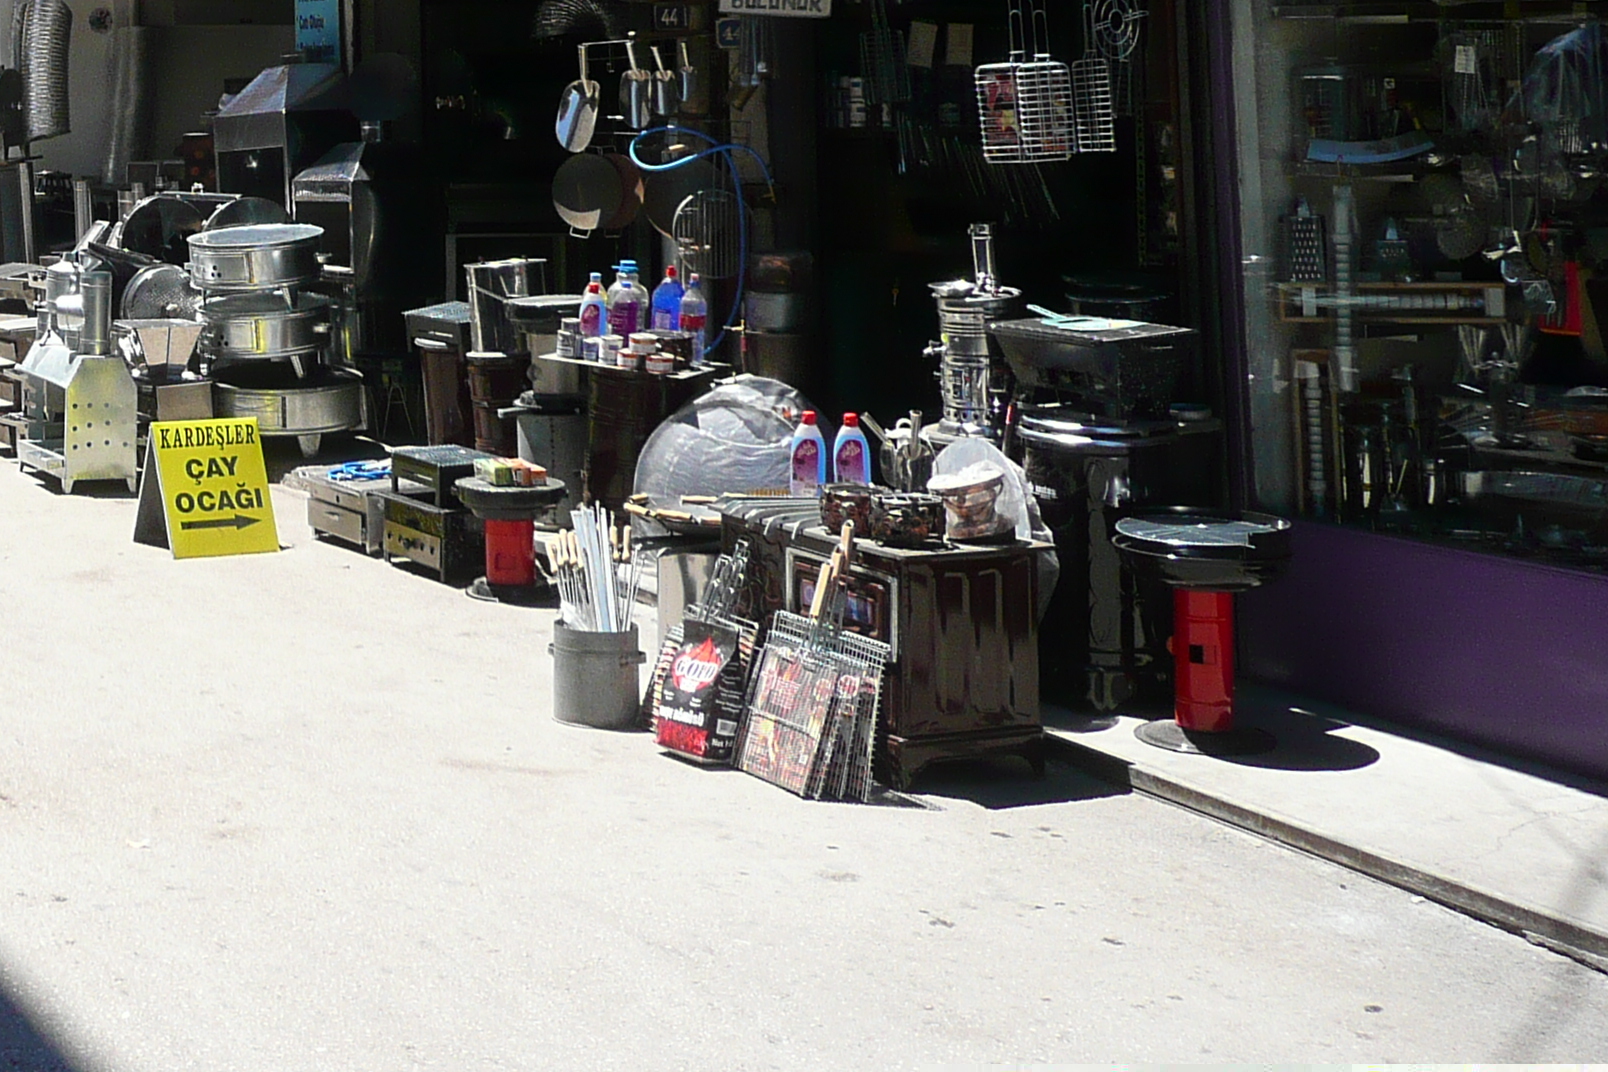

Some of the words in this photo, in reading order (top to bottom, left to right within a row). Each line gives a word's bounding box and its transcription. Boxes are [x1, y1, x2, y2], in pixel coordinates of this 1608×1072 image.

[660, 8, 680, 27] 44
[159, 424, 255, 451] KARDEŞLER
[185, 455, 238, 486] ÇAY
[175, 481, 264, 514] OCAĞI
